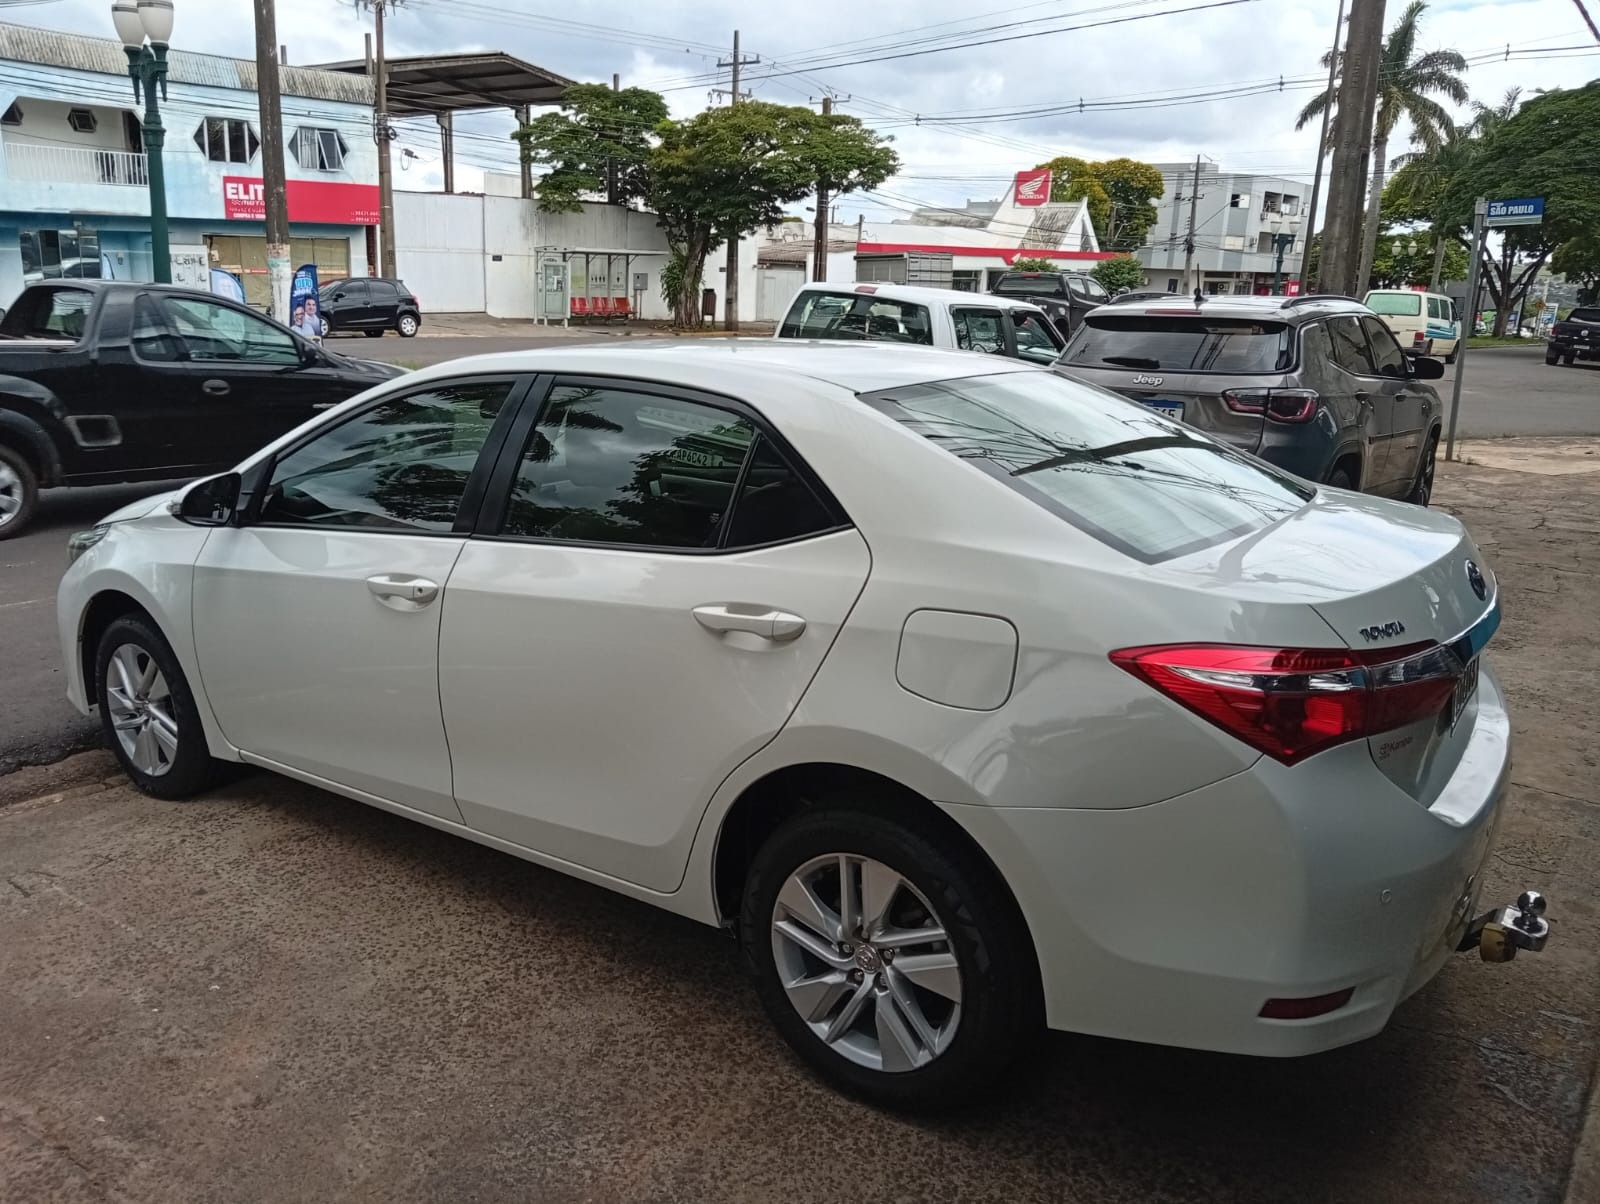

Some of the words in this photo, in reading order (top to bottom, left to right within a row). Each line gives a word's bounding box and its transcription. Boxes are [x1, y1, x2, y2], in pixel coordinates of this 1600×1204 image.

[1490, 204, 1507, 216] SÃO
[1508, 204, 1534, 215] PAULO
[1133, 375, 1163, 386] Jeep
[1360, 620, 1405, 642] TOYOTA
